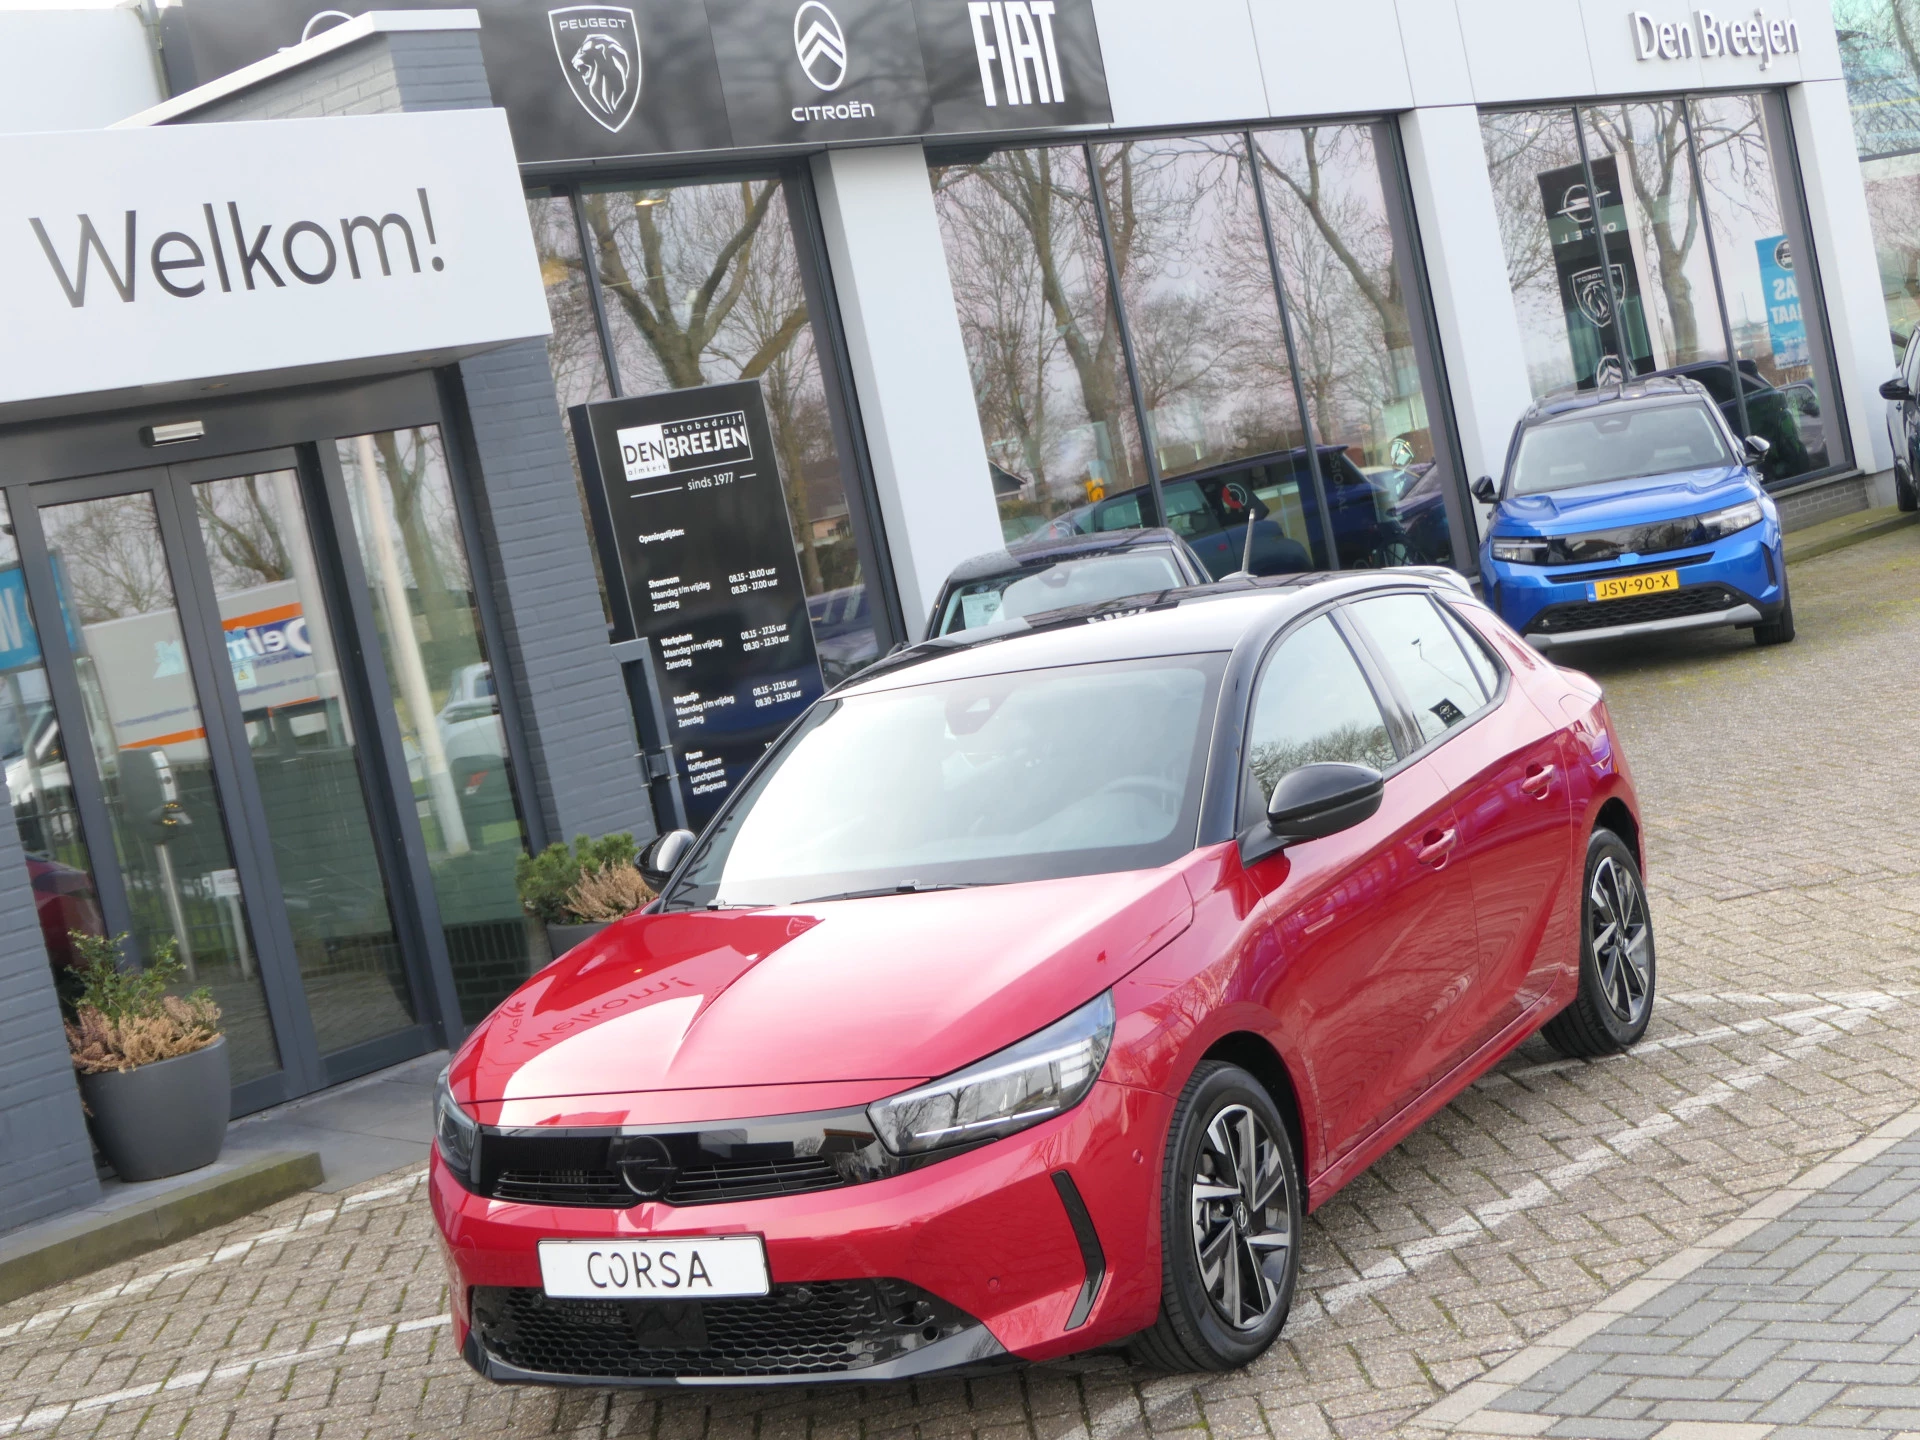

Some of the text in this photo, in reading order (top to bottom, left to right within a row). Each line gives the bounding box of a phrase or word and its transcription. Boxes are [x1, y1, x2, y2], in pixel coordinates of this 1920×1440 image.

[558, 17, 628, 31] PEUGEOT
[1630, 8, 1800, 70] Den Breejen
[967, 0, 1066, 107] FIAT
[28, 187, 446, 308] Welkom!
[663, 414, 743, 435] autobedrijf
[623, 426, 748, 465] DEN BREEJEN
[627, 464, 668, 476] almkerk
[687, 472, 734, 490] sinds 1977
[648, 576, 680, 589] Showroom
[1600, 574, 1671, 597] JSV-90-X
[651, 587, 679, 600] Maandag
[653, 600, 680, 612] Zaterdag
[660, 633, 693, 647] Werkplaats
[663, 646, 691, 659] Maandag
[665, 658, 692, 671] Zaterdag
[675, 703, 703, 716] Maandag
[678, 715, 704, 728] Zaterdag
[685, 751, 703, 760] Pauze
[687, 757, 722, 772] Koffiepauze
[690, 769, 725, 784] Lunchpauze
[692, 780, 727, 795] Koffiepauze
[587, 1251, 713, 1289] CORSA
